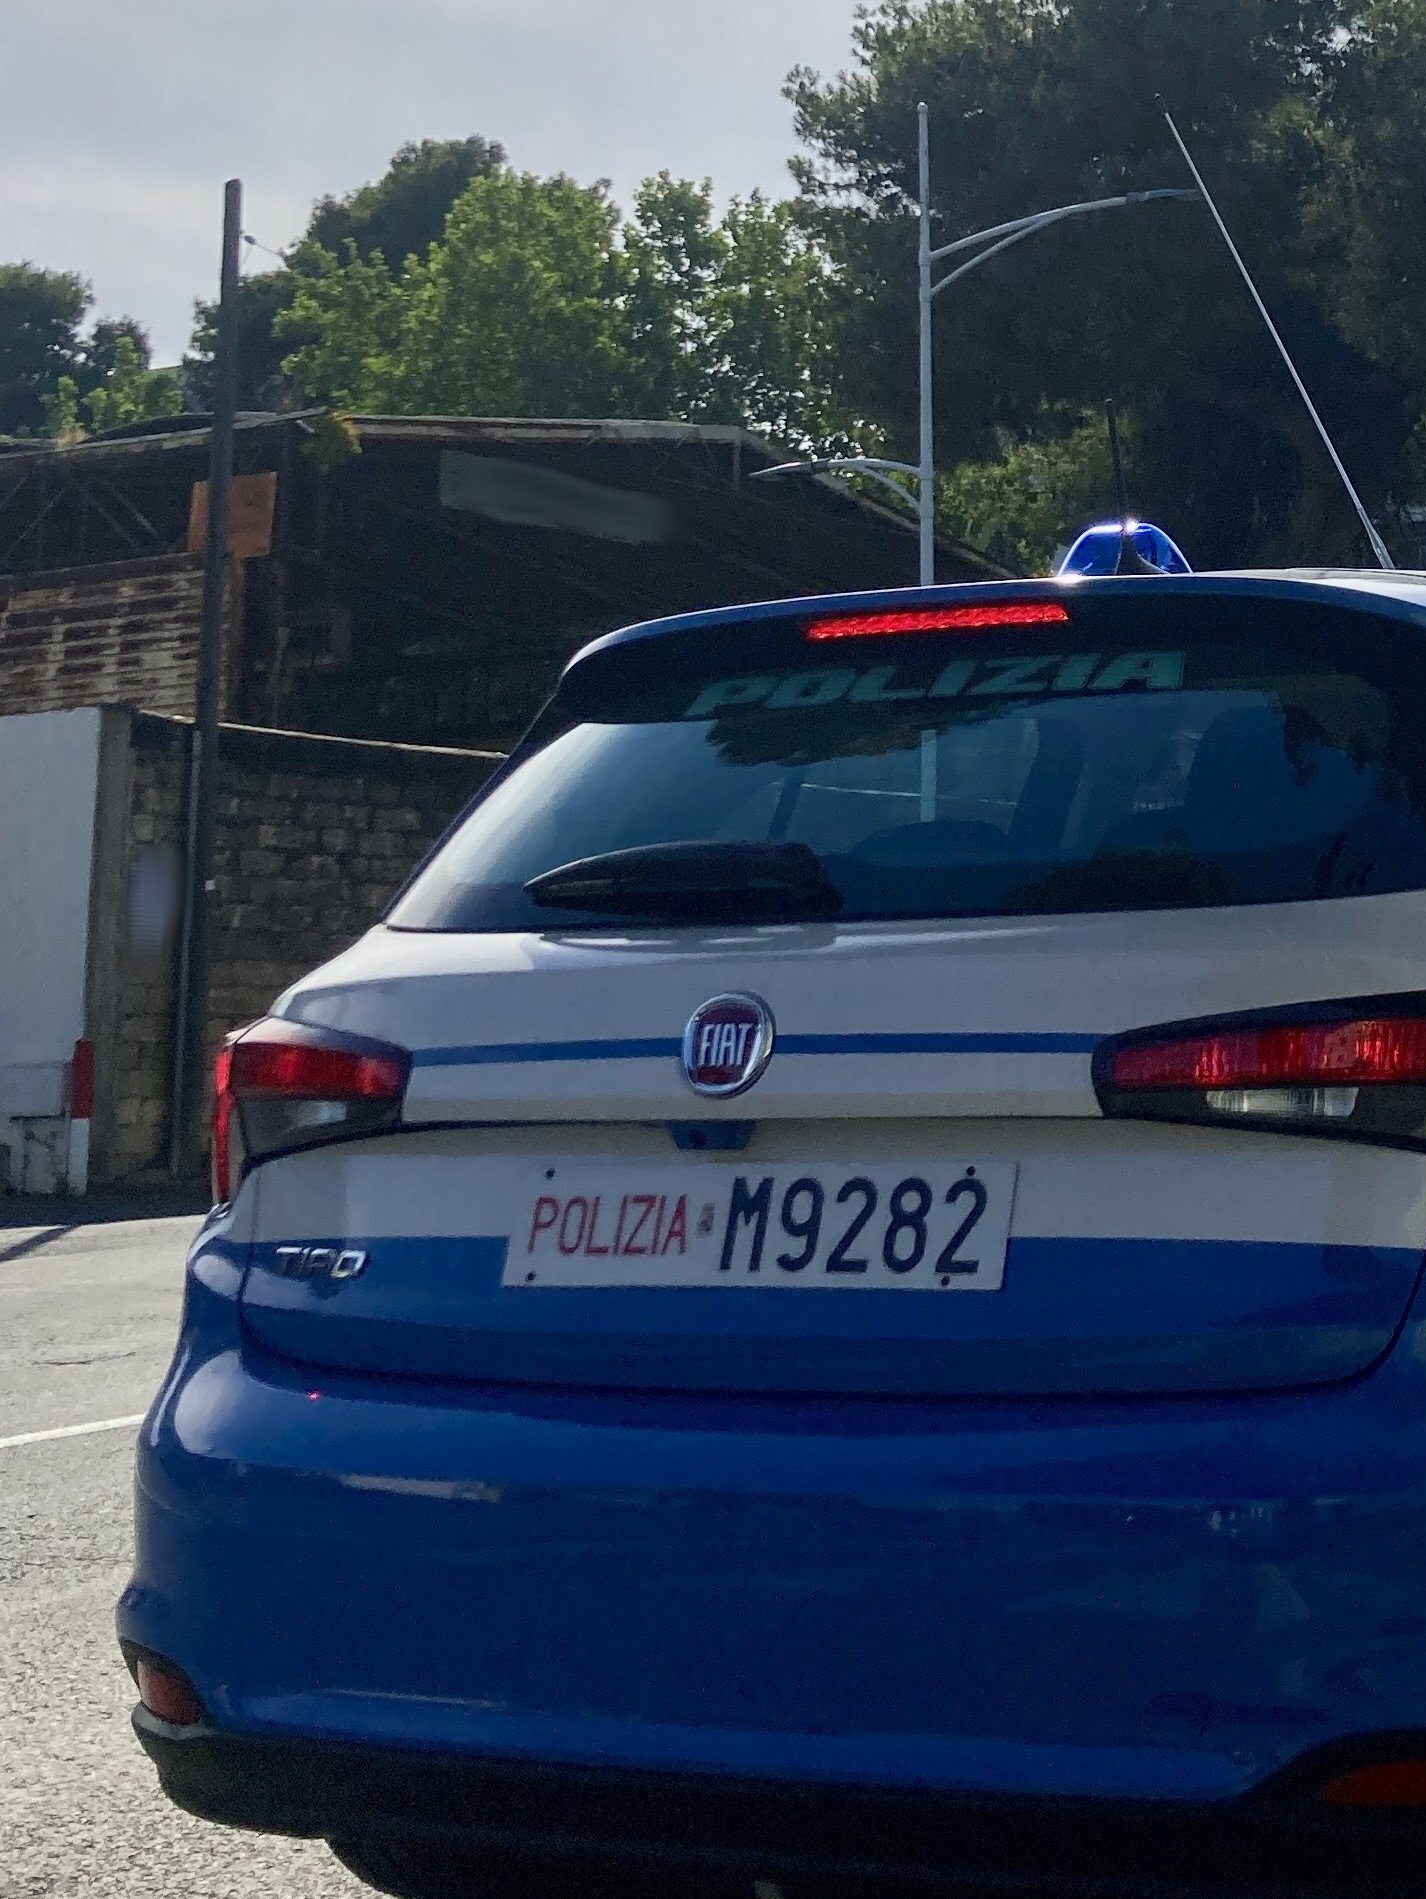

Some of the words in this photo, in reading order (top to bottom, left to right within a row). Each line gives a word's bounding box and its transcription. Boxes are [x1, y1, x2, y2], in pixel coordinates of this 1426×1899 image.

[685, 651, 1185, 716] POLIZIA
[700, 1023, 754, 1066] FIAT
[527, 1195, 689, 1256] POLIZIA
[719, 1177, 988, 1274] M9282
[276, 1246, 366, 1278] TIPO
